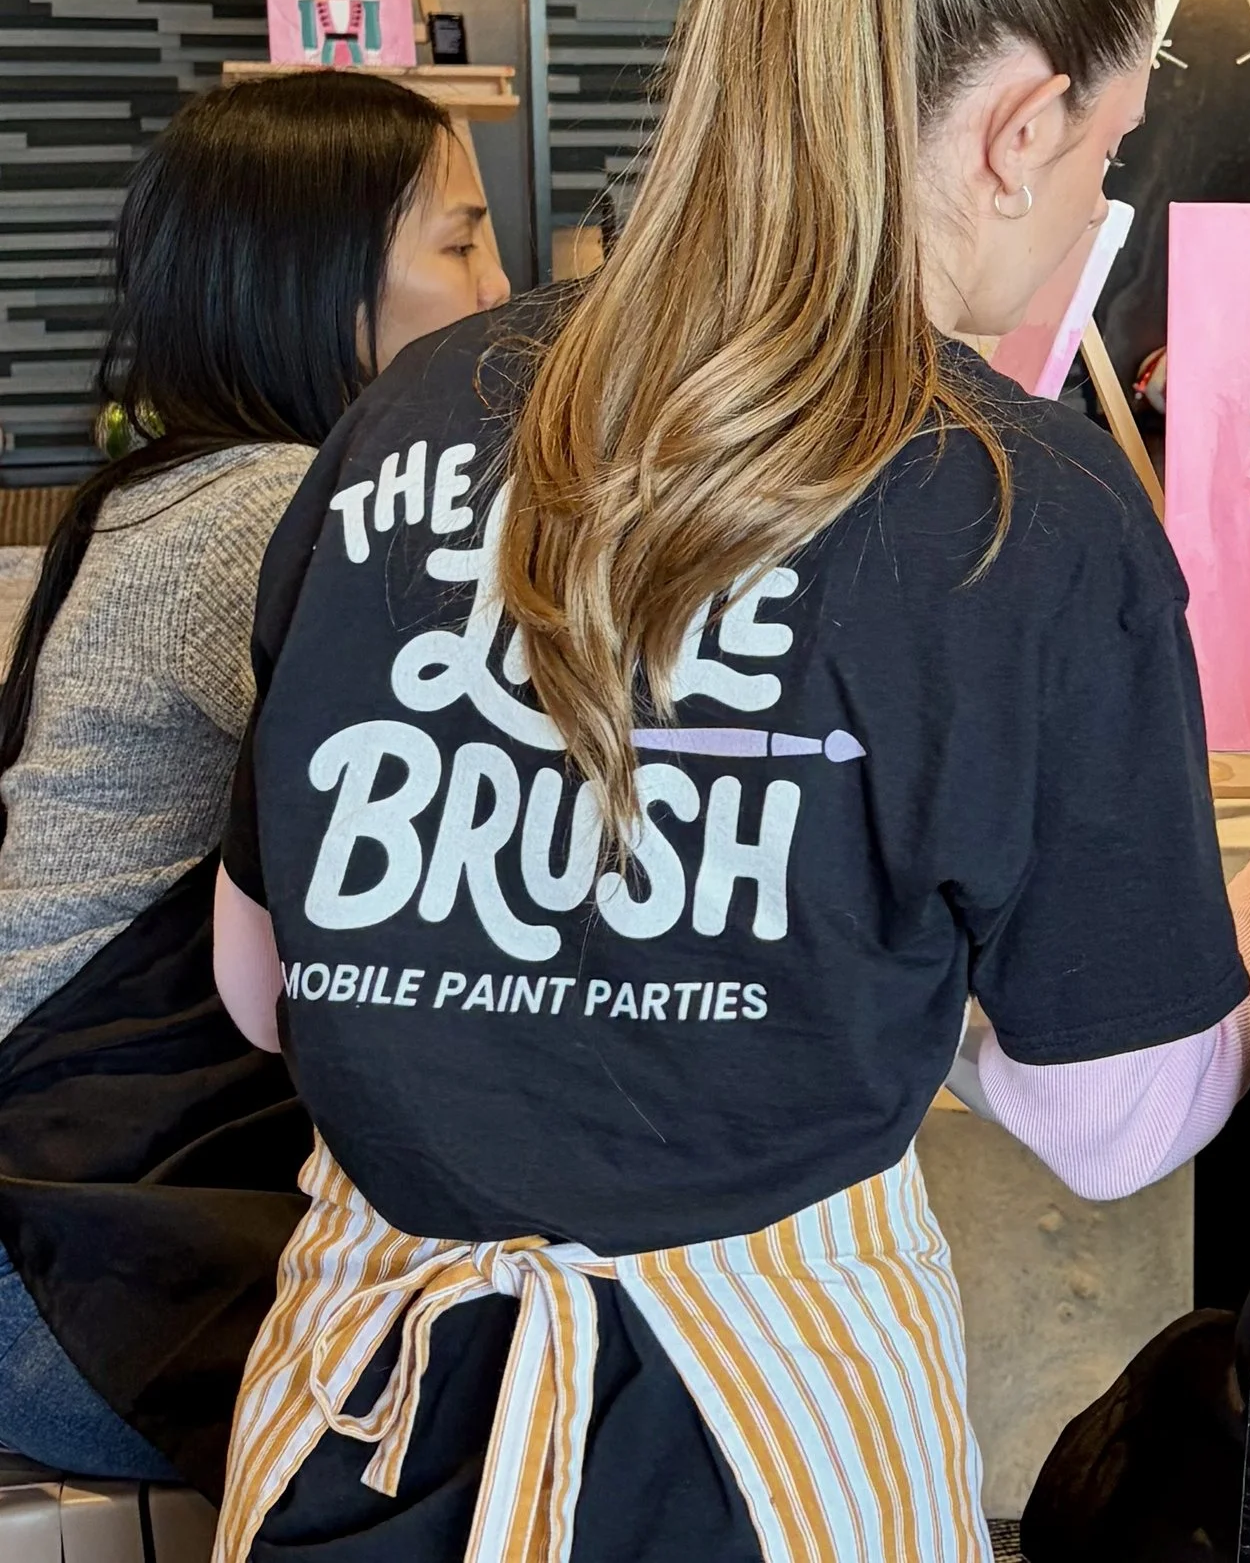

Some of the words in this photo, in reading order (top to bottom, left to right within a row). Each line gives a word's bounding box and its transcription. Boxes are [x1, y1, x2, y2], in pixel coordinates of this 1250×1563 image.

[330, 440, 476, 564] THE
[304, 720, 801, 962] BRUSH
[281, 961, 426, 1007] MOBILE
[433, 971, 576, 1015] PAINT
[584, 979, 768, 1021] PARTIES
